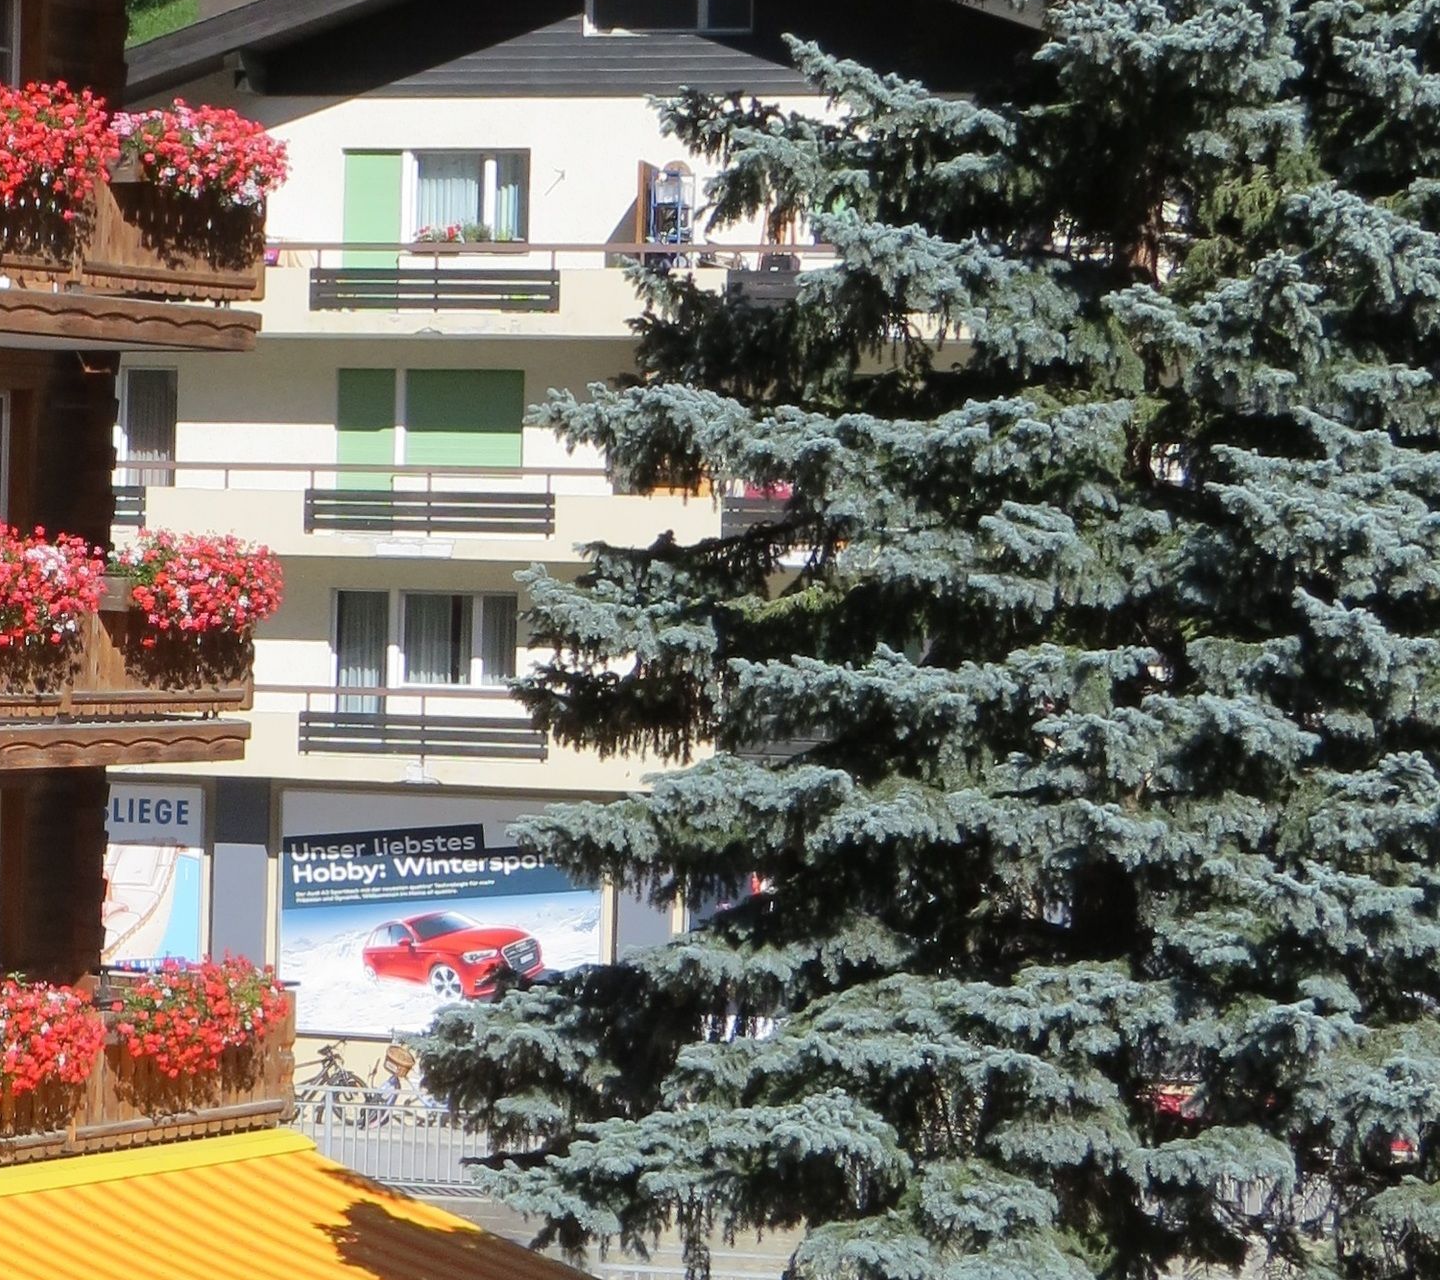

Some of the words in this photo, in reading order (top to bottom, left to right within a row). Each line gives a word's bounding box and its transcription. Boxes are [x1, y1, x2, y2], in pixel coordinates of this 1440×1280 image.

[291, 842, 365, 861] Unser
[374, 835, 476, 856] liebstes
[292, 861, 387, 884] Hobby:
[393, 853, 561, 877] Winterspor
